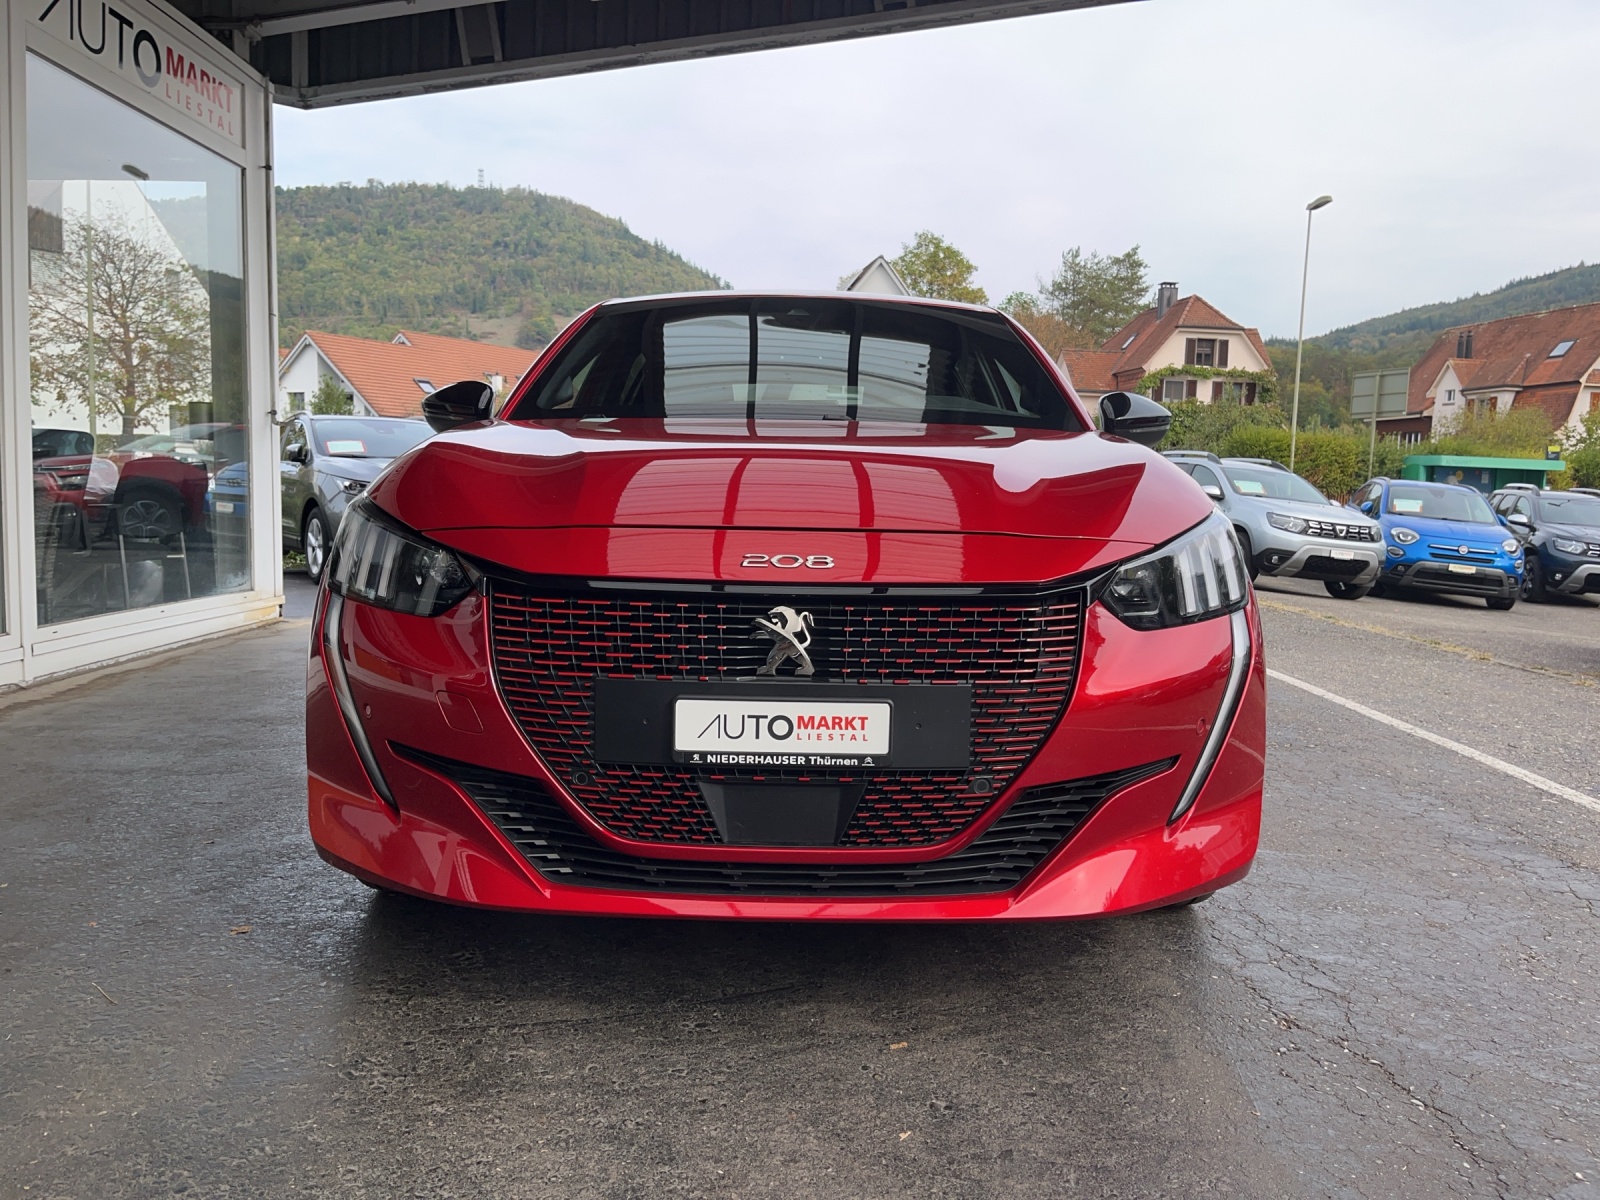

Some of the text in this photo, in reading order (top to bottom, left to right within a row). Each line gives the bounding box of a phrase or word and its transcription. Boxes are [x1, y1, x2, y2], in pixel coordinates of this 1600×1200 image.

[38, 0, 234, 113] AUTO MARKT
[165, 82, 234, 136] LIESTAL
[741, 553, 835, 569] 208
[697, 714, 869, 741] AUTO MARKT
[796, 733, 869, 742] LIESTAL
[706, 754, 859, 766] NIEDERHAUSER Thürnen
